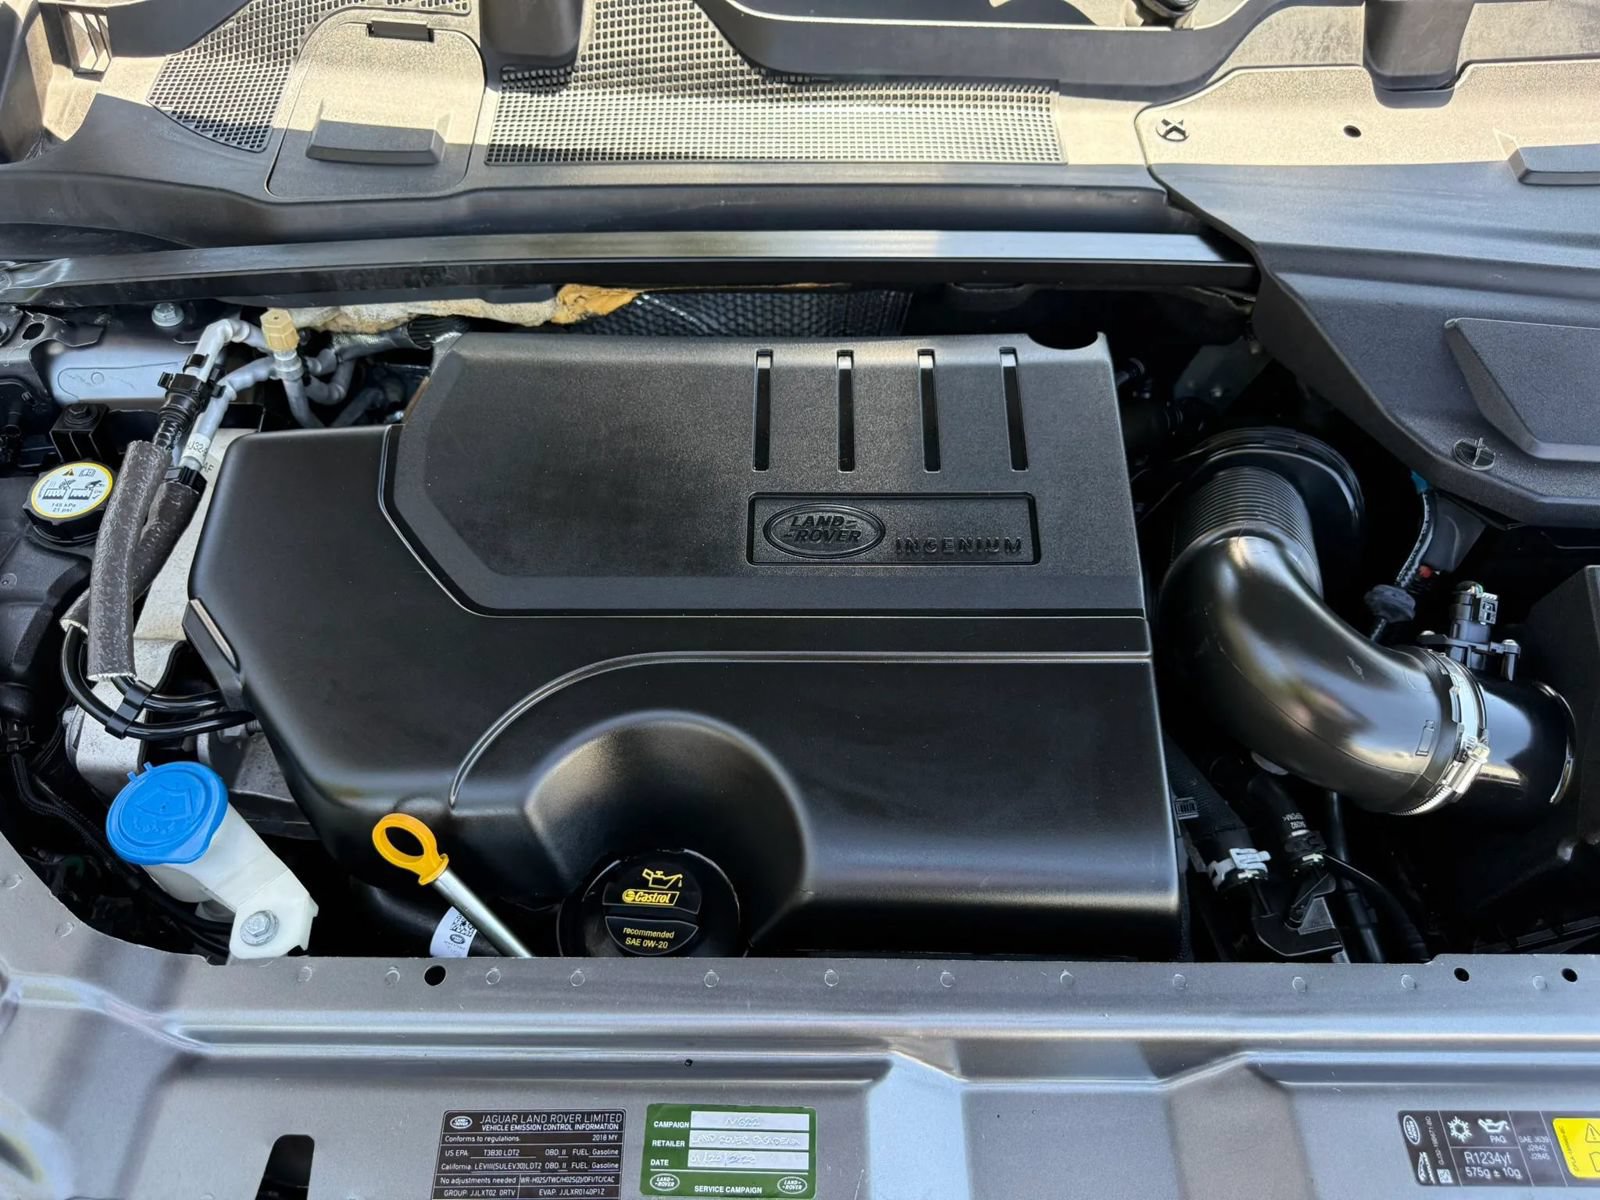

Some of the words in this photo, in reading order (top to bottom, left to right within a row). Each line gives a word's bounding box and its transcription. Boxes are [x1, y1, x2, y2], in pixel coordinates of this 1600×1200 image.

[790, 514, 845, 528] LAND
[793, 528, 863, 544] ROVER
[895, 536, 1023, 555] INGENIUM
[634, 891, 672, 904] Castrol
[623, 927, 675, 939] recommended
[625, 937, 641, 946] SAE
[642, 940, 669, 949] 0W-20
[479, 1114, 518, 1124] JAGUAR
[520, 1113, 548, 1123] LAND
[550, 1113, 582, 1123] ROVER
[584, 1113, 623, 1123] LIMITED
[591, 1161, 619, 1169] Gasoline
[1463, 1151, 1512, 1167] R1234yf
[1464, 1166, 1491, 1180] 575g
[1502, 1167, 1523, 1180] 10g
[450, 1177, 491, 1186] adjustments
[694, 1185, 724, 1193] SERVICE
[725, 1186, 763, 1194] CAMPAIGN
